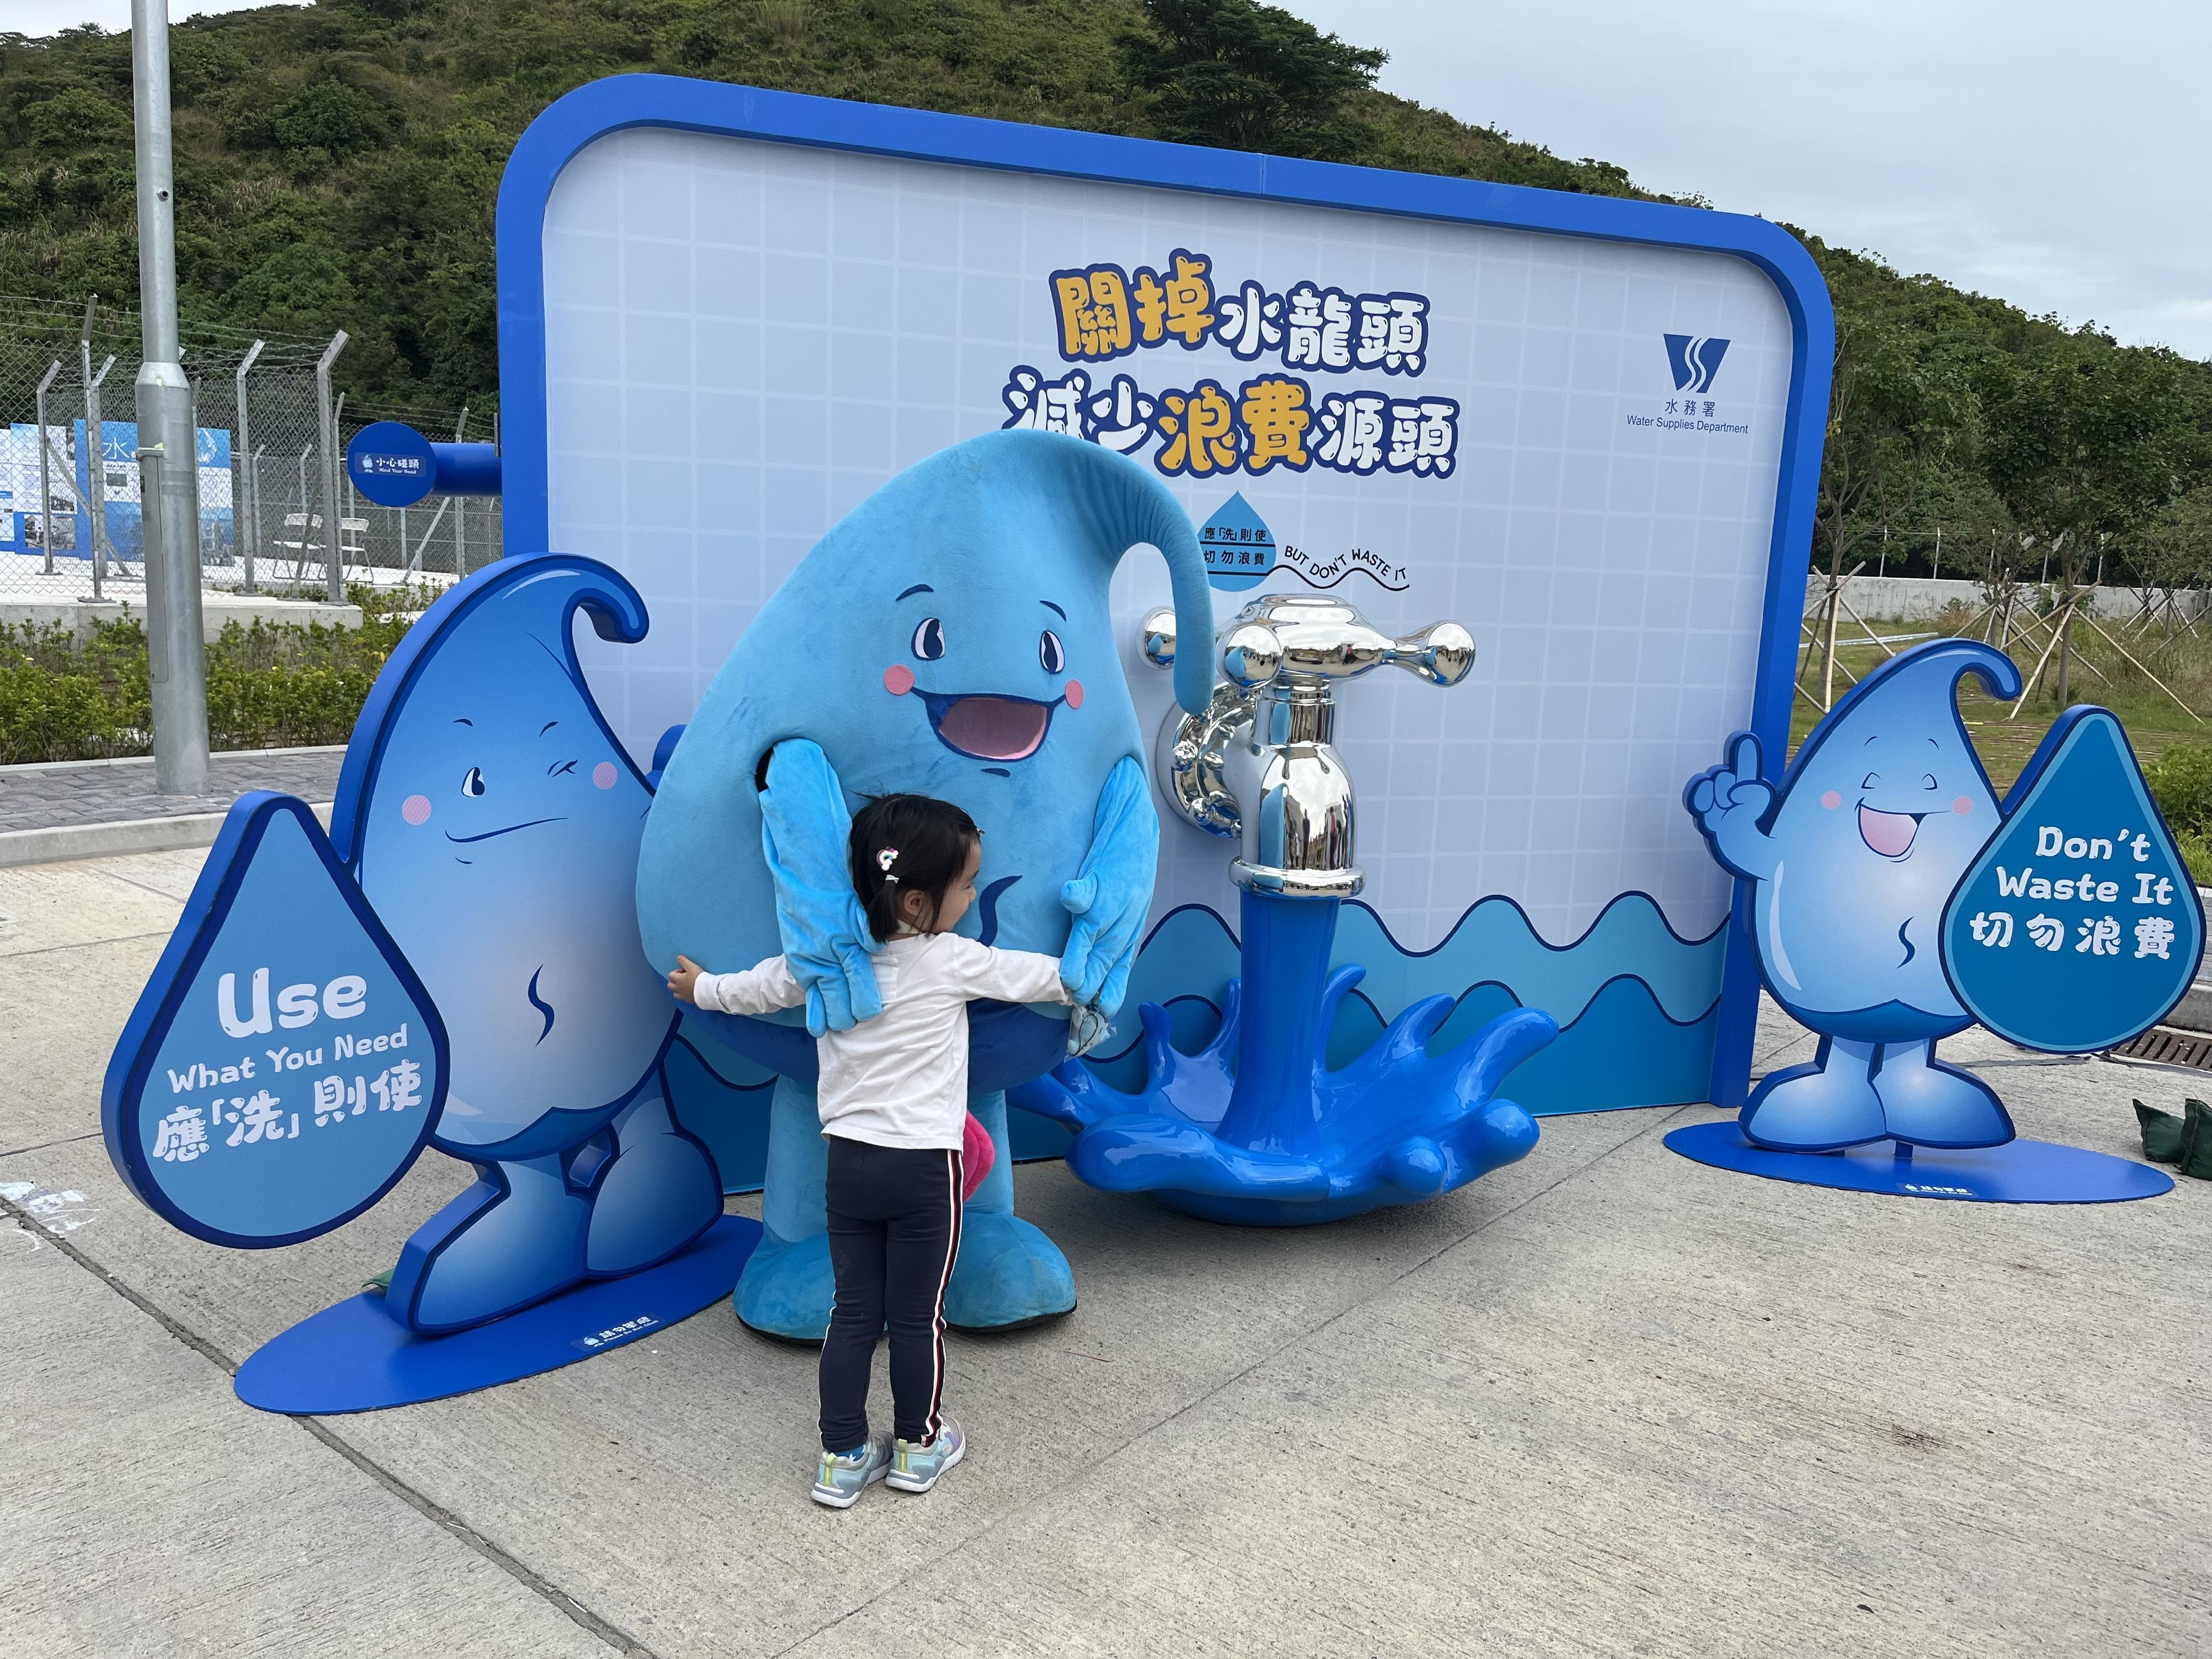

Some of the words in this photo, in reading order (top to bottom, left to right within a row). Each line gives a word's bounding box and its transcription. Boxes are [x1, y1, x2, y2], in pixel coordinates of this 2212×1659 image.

[1051, 249, 1429, 376] 關掉水龍頭
[1003, 367, 1458, 478] 減少浪費源頭
[1627, 415, 1654, 427] Water
[1656, 417, 1694, 431] Supplies
[1697, 420, 1749, 434] Department
[1665, 398, 1715, 418] 水務署
[376, 457, 419, 469] 小心碰頭
[1203, 549, 1265, 566] 切勿浪費
[1284, 545, 1310, 566] BUT
[1309, 554, 1347, 579] DON'T
[1352, 548, 1391, 577] WASTE
[1394, 567, 1407, 581] IT
[2035, 826, 2151, 862] Don't
[1996, 866, 2119, 902] Waste
[2131, 873, 2174, 905] It
[1969, 911, 2175, 960] 切勿浪費
[217, 967, 367, 1038] Use
[166, 1056, 256, 1093] What
[265, 1046, 323, 1073] You
[334, 1023, 408, 1061] Need
